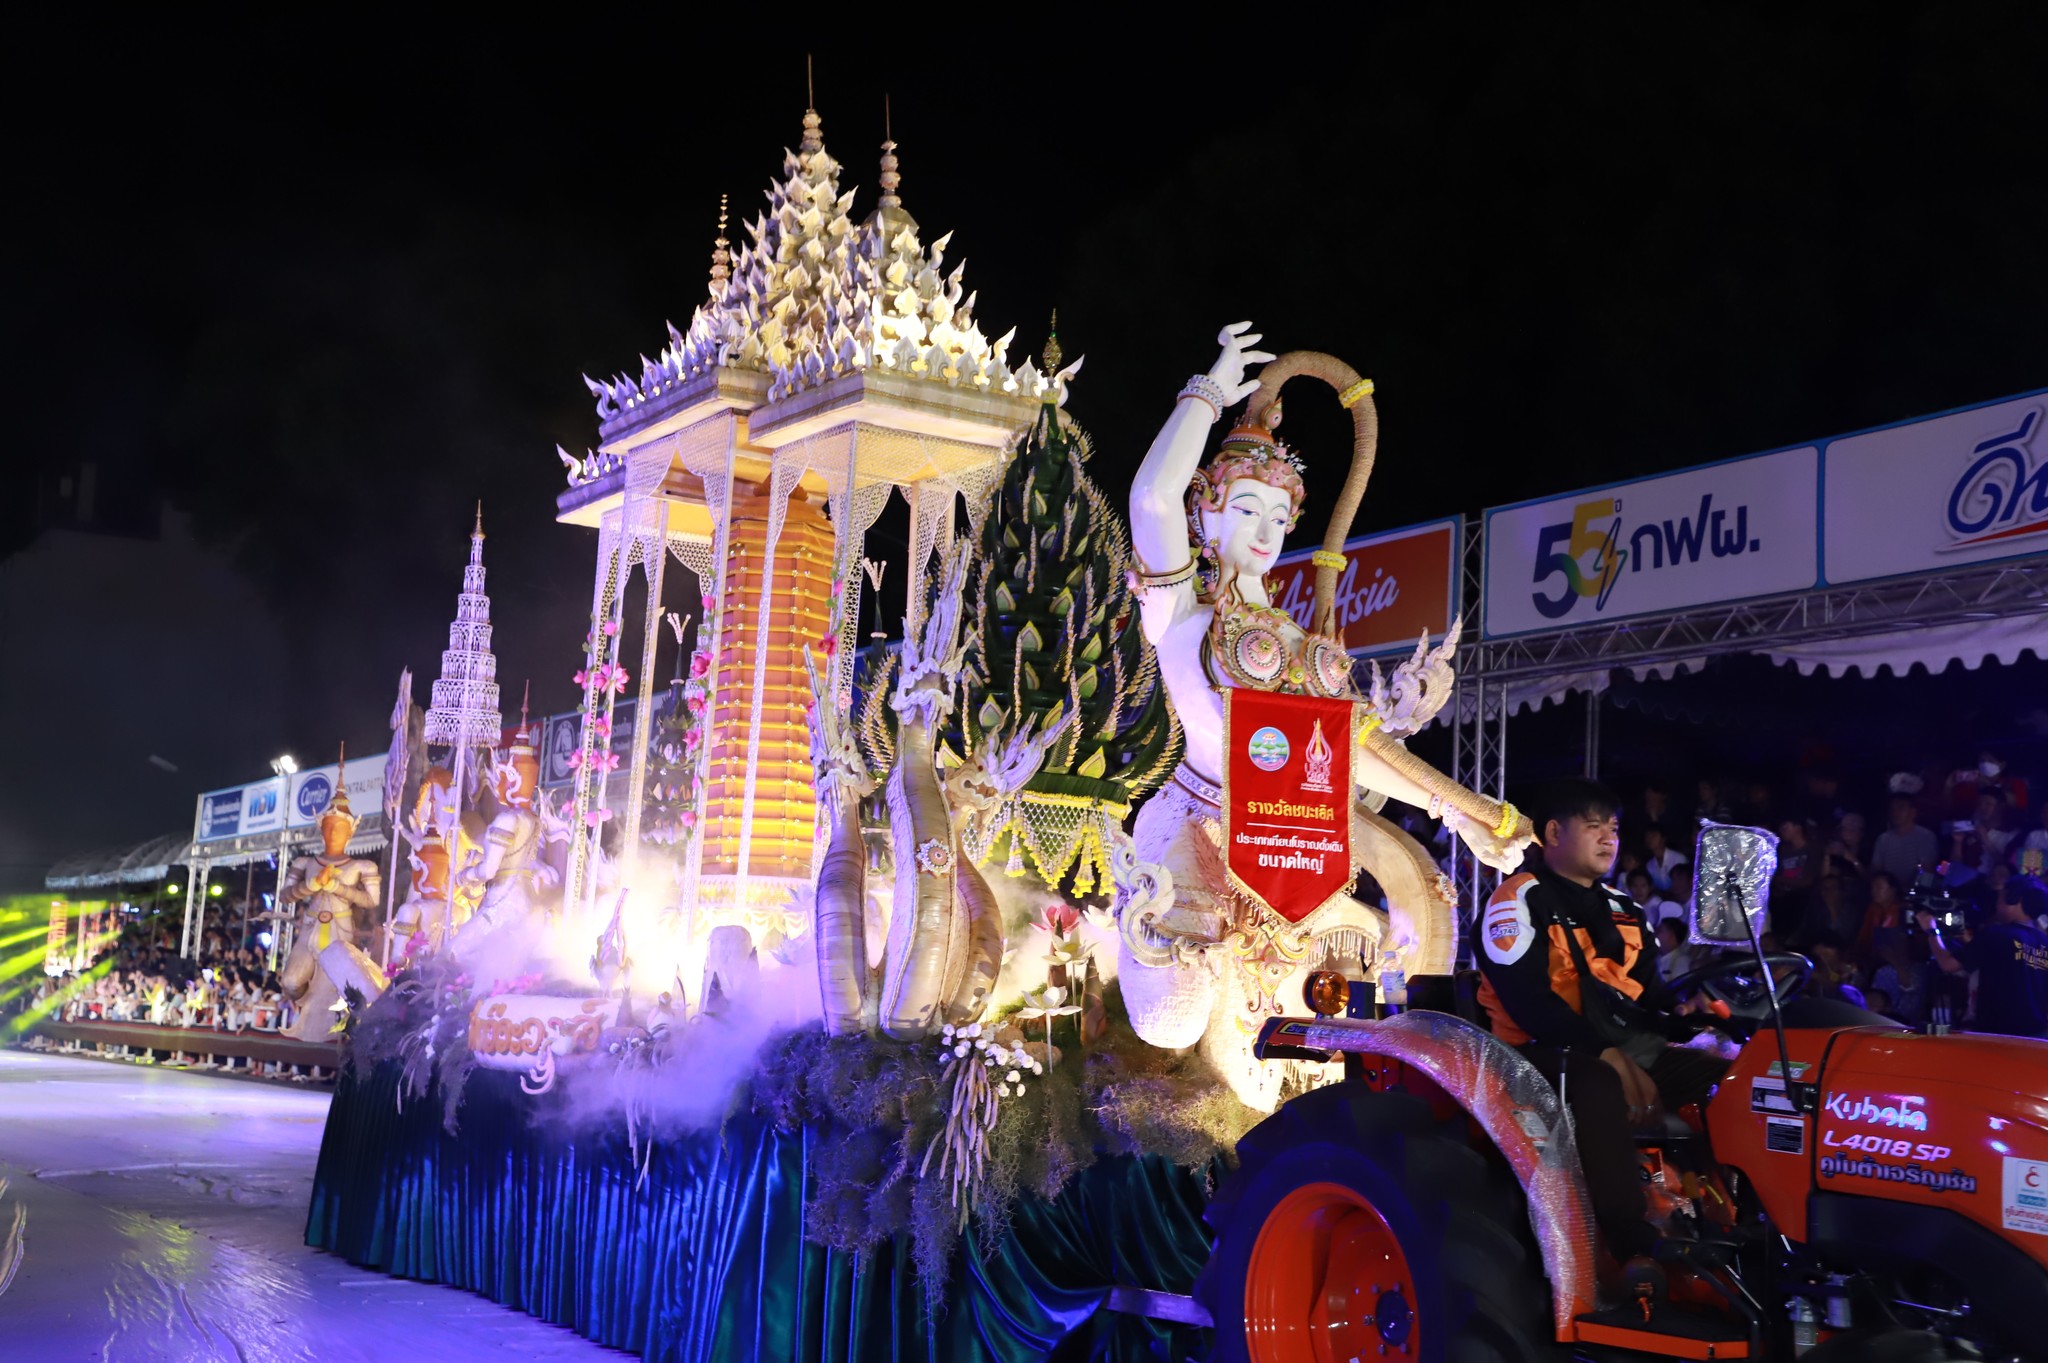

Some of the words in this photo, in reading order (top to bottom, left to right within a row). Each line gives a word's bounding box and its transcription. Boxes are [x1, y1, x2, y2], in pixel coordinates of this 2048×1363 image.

[1532, 498, 1617, 619] 55
[1630, 493, 1760, 573] กฟผ.
[1280, 557, 1400, 629] AiAsia
[1247, 799, 1335, 821] รางวัลชนะเลิศ
[1258, 850, 1325, 875] ขนาดใหญ่
[1825, 1092, 1928, 1132] Kubota
[1823, 1130, 1912, 1158] L4018
[1912, 1144, 1952, 1162] SP
